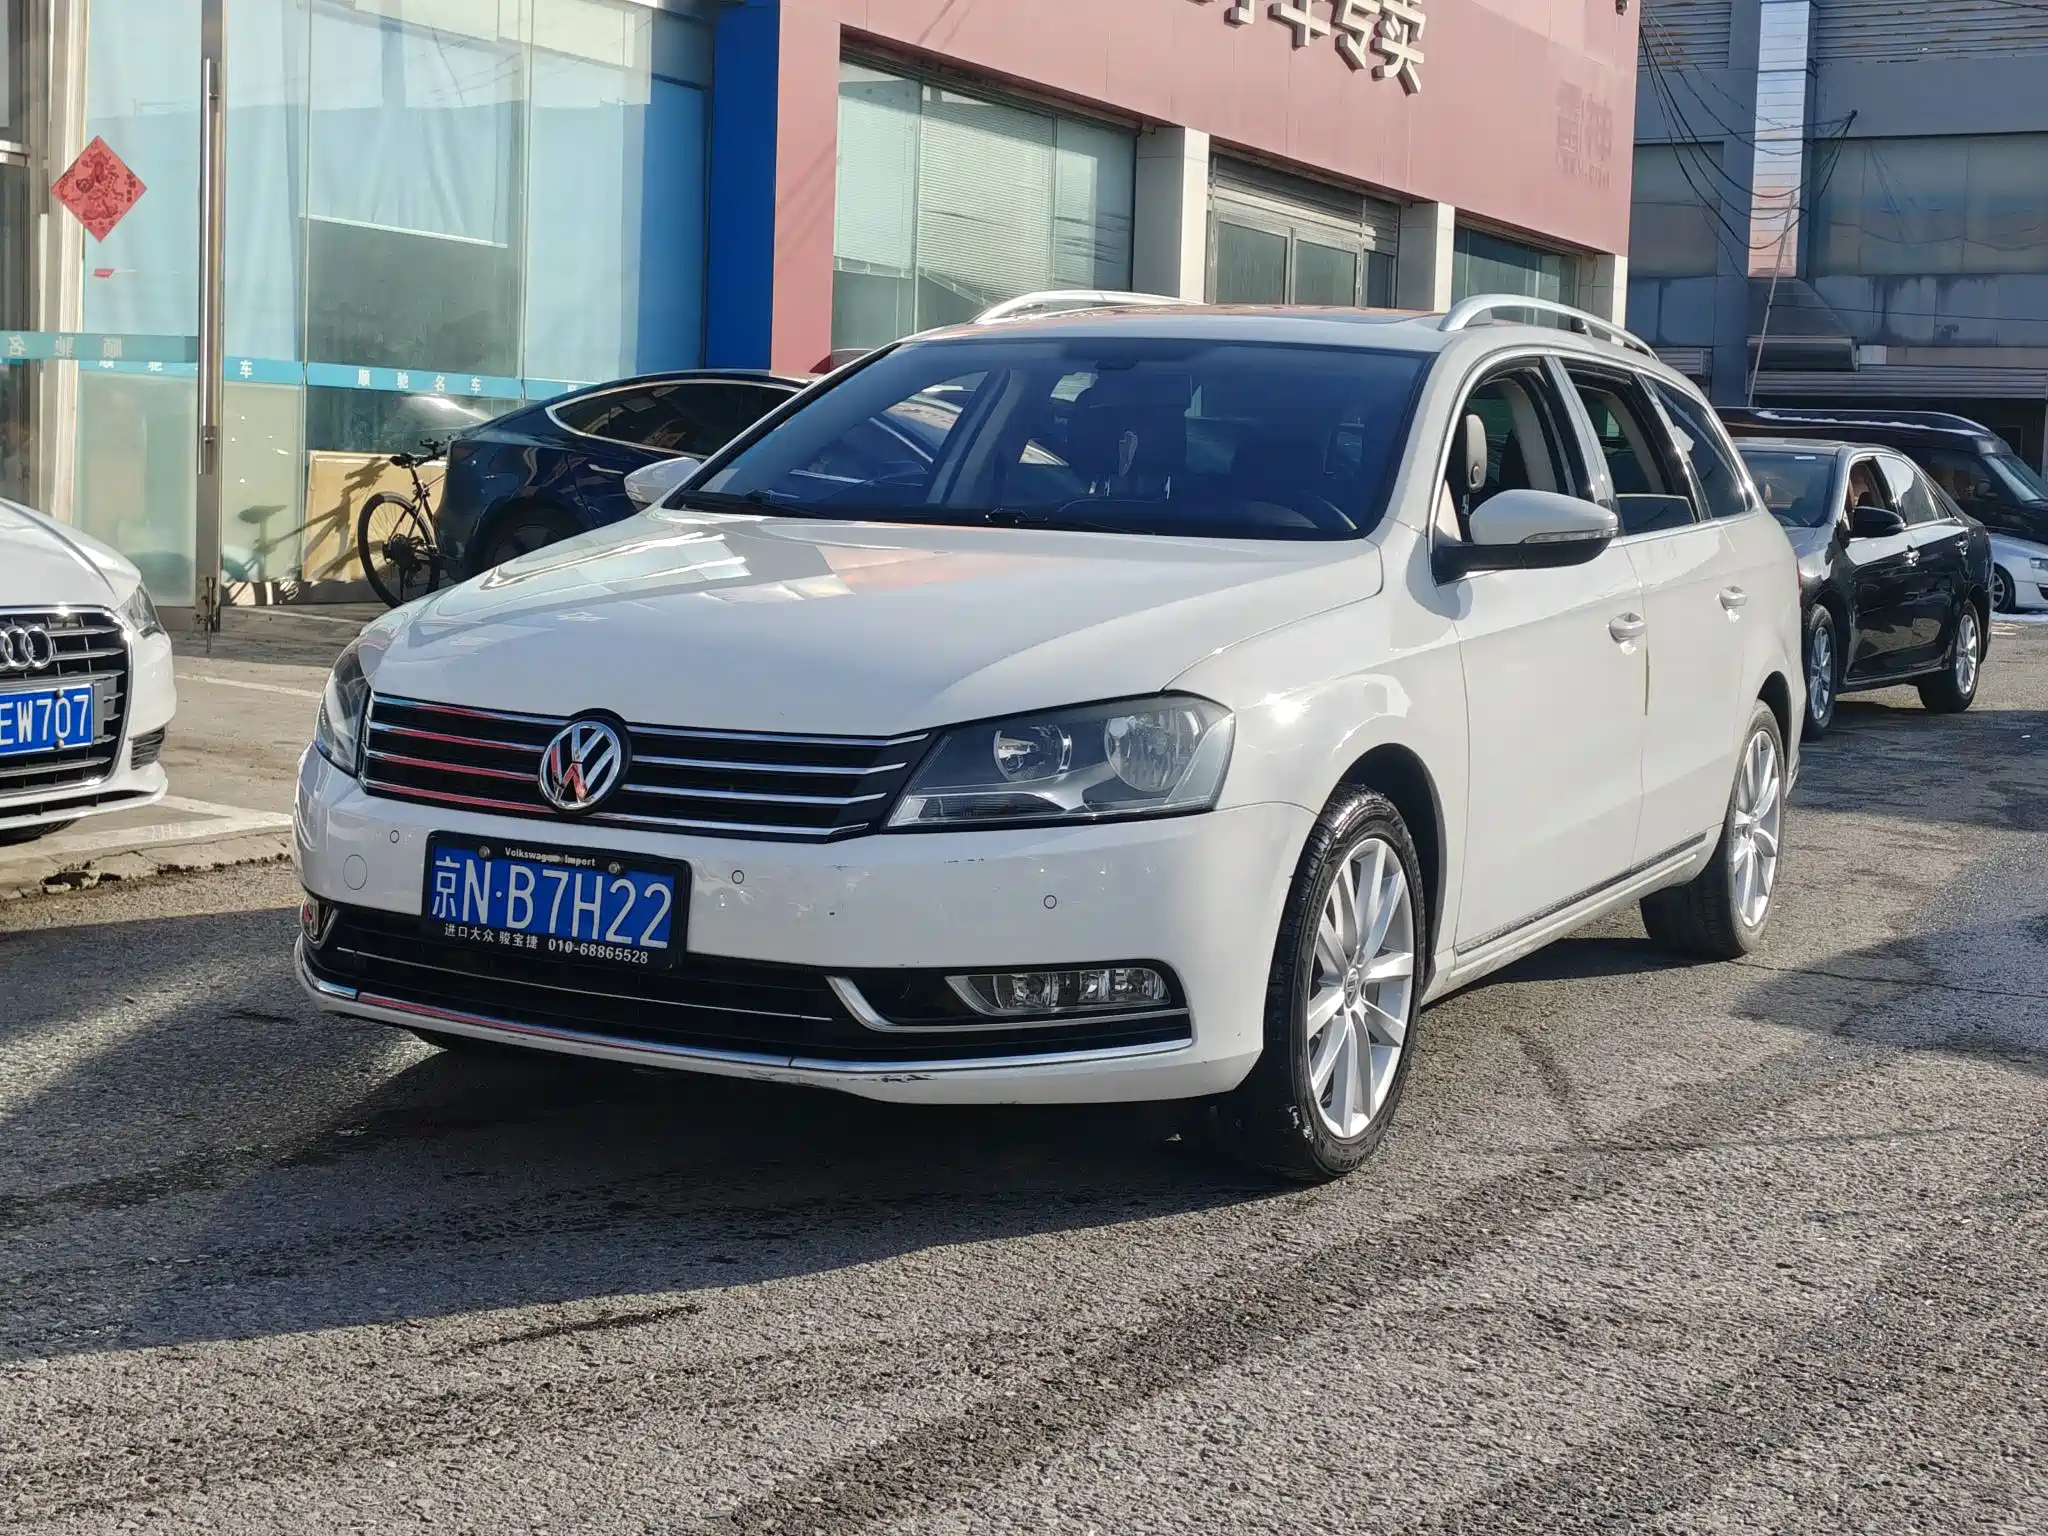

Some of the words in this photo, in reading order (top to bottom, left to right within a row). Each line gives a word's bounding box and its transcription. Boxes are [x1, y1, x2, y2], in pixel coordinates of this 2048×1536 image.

[0, 694, 90, 747] EW707
[564, 854, 596, 867] Import
[443, 922, 495, 944] 进口大众
[498, 931, 539, 950] 骏宝捷
[547, 937, 649, 966] 010-68865528
